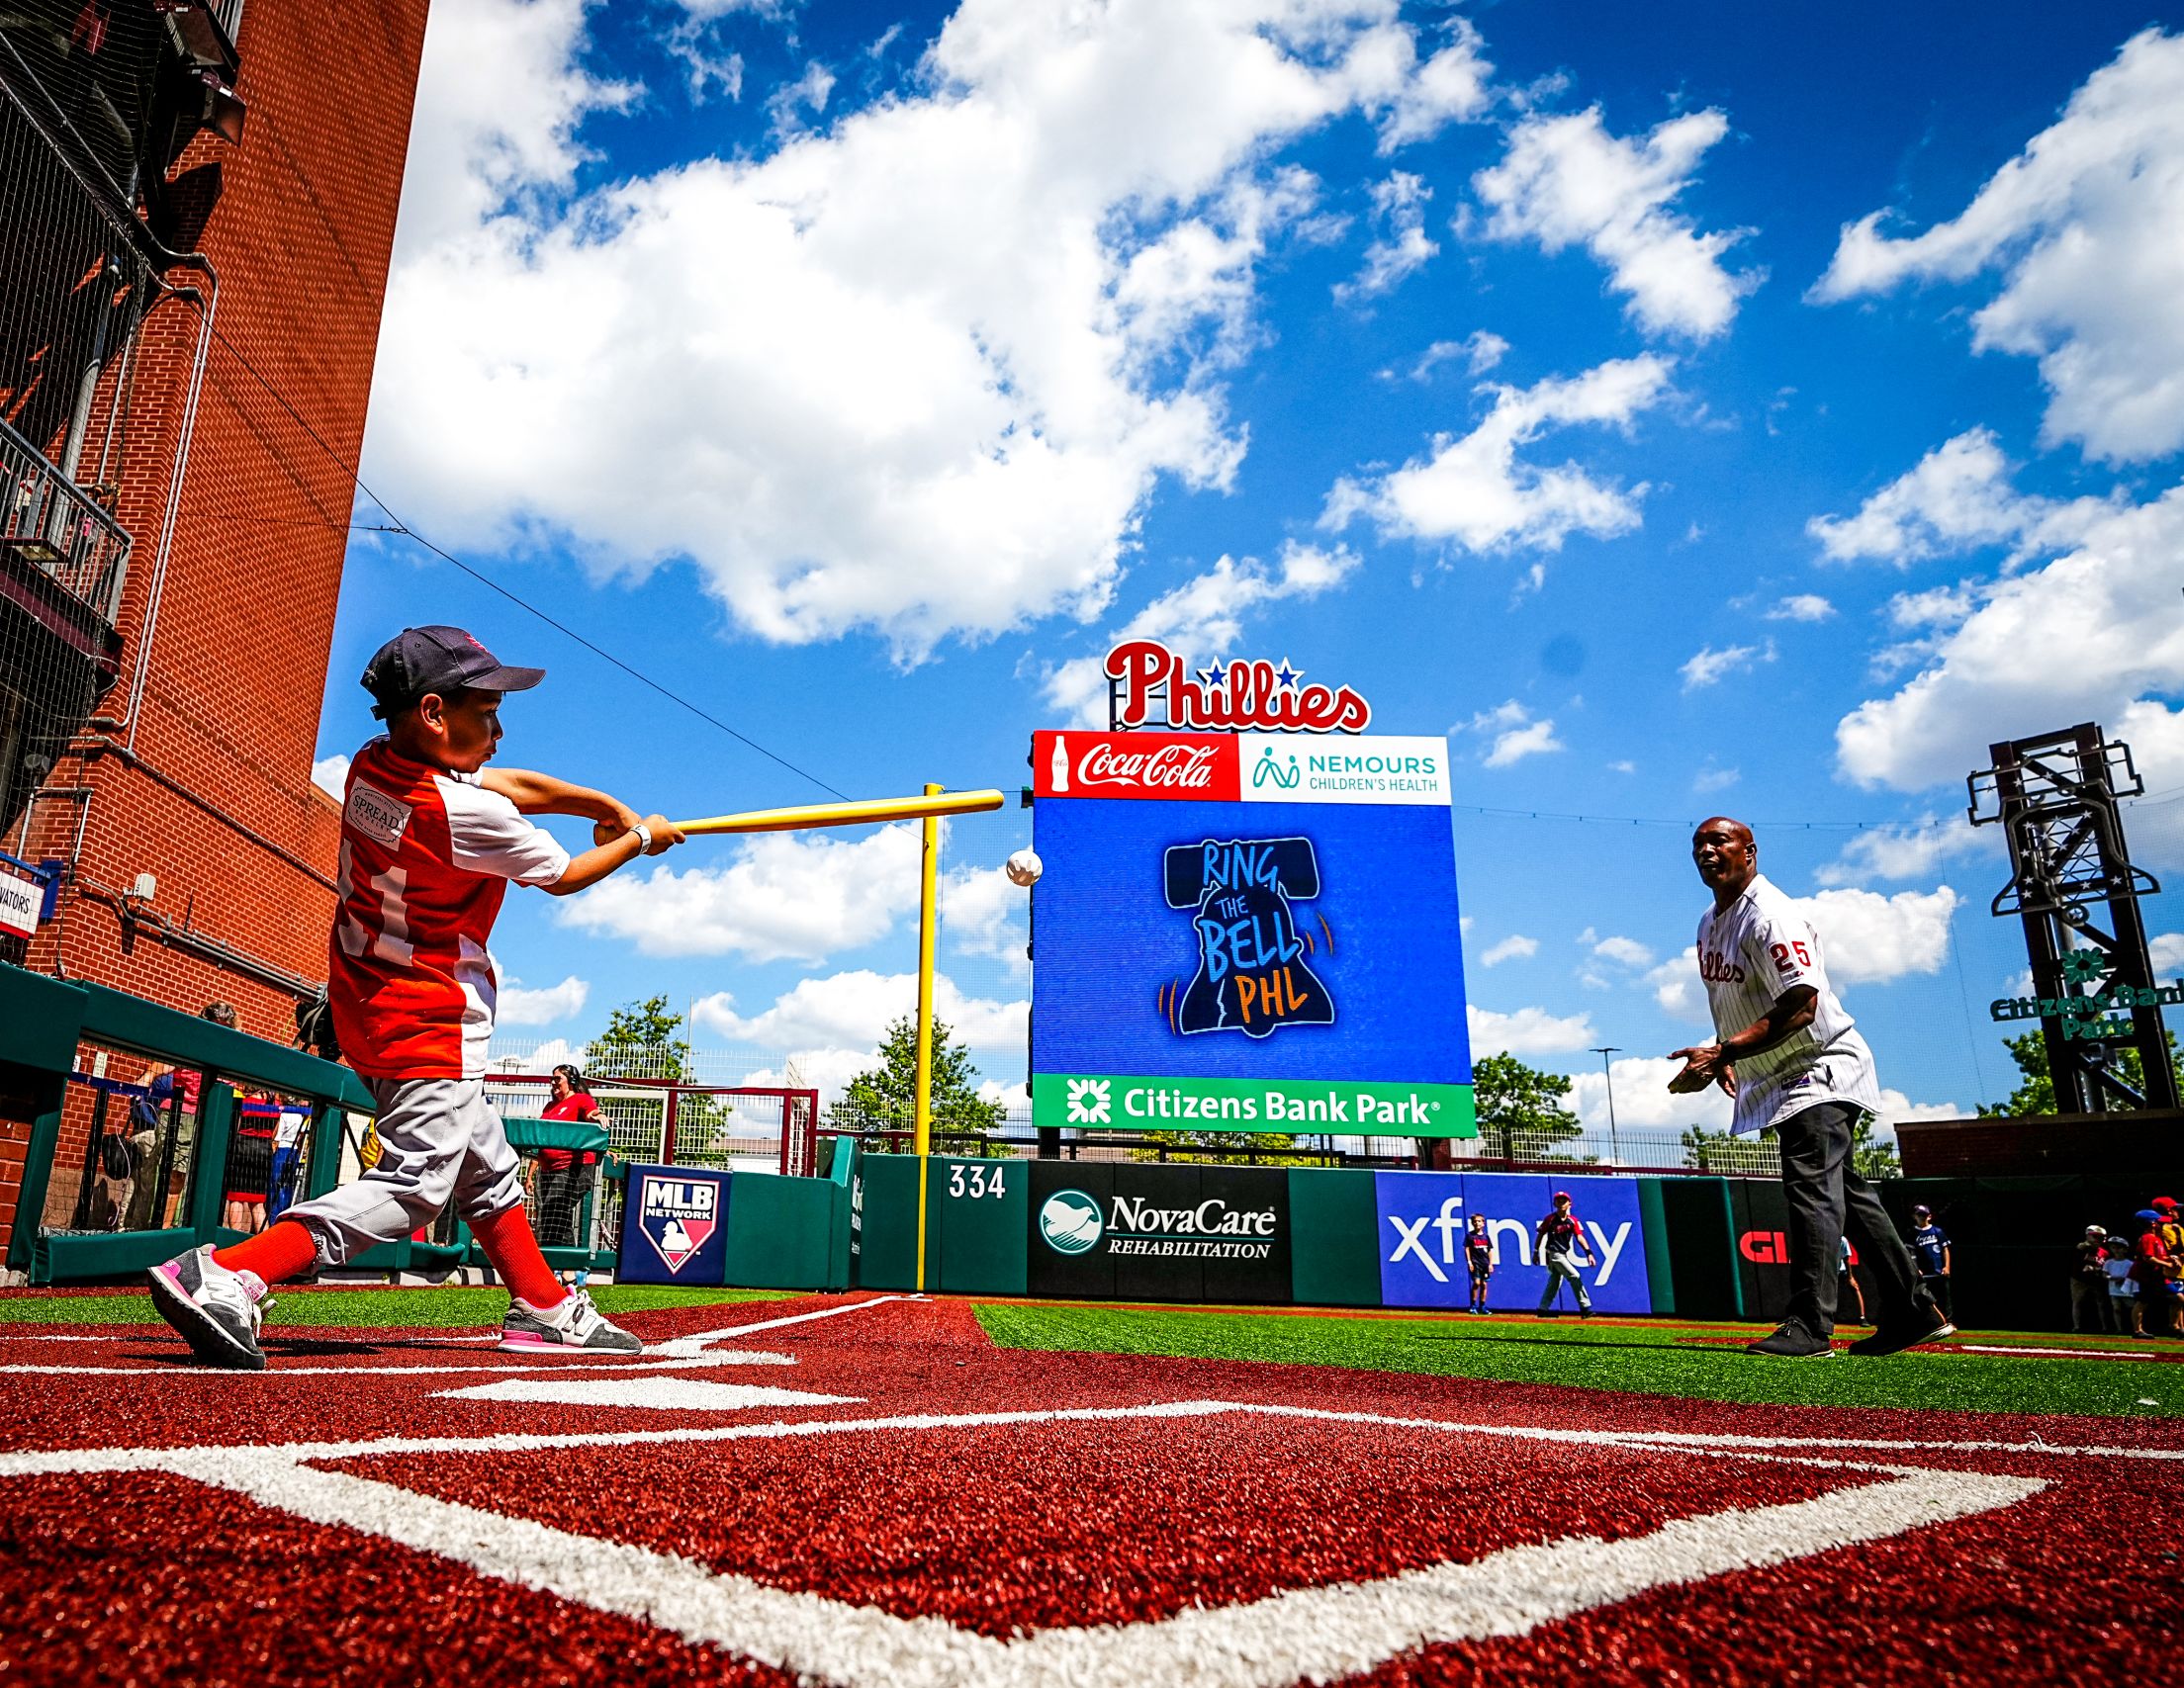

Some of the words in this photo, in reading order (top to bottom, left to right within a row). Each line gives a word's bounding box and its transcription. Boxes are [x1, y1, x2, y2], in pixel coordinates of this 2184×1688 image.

[1104, 639, 1371, 732] Phillies
[1077, 743, 1220, 788] Coca-Cola
[1309, 755, 1436, 774] NEMOURS
[1310, 777, 1386, 791] CHILDREN'S
[1389, 778, 1438, 792] HEALTH
[352, 794, 400, 830] SPREAD
[1203, 844, 1279, 893] RING
[1215, 895, 1249, 920] THE
[1198, 911, 1300, 983] BELL
[1769, 940, 1811, 973] 25
[1234, 966, 1309, 1023] PHL
[1990, 992, 2110, 1022] Citizens
[2061, 1013, 2134, 1040] Park
[1124, 1088, 1258, 1120] Citizens
[1265, 1091, 1349, 1122] Bank
[646, 1181, 714, 1211] MLB
[949, 1164, 1006, 1199] 334
[645, 1207, 711, 1220] NETWORK
[1107, 1239, 1271, 1259] REHABILITATION
